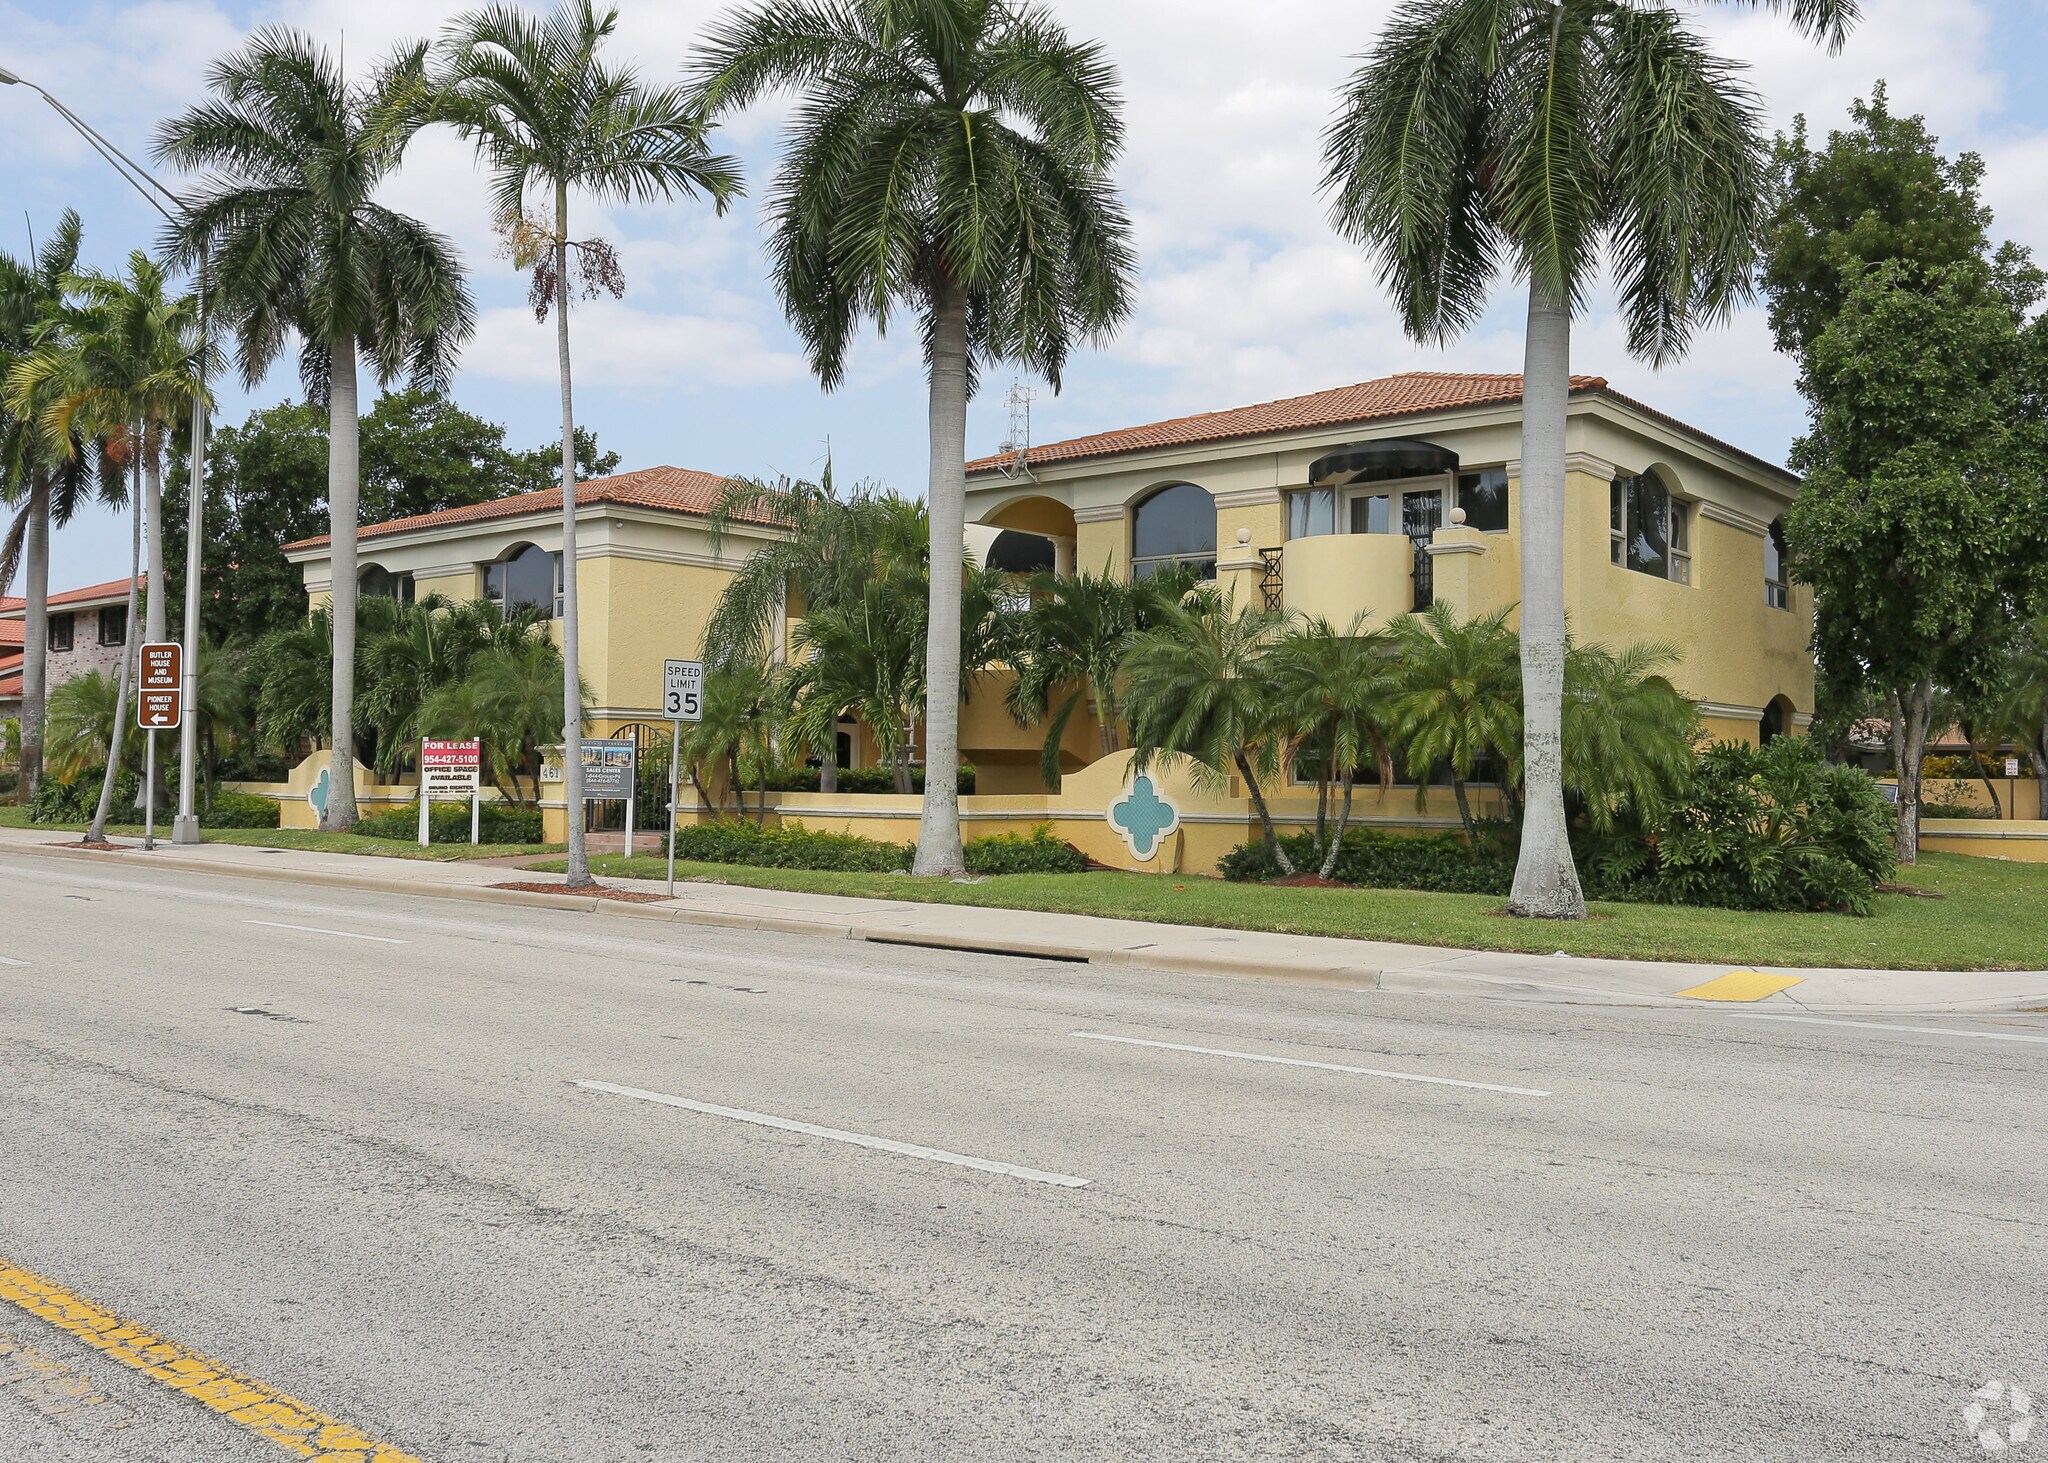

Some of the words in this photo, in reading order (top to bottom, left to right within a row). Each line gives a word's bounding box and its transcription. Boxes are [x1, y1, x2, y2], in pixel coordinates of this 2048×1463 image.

[667, 666, 701, 678] SPEED
[670, 679, 697, 689] LIMIT
[667, 692, 698, 715] 35
[424, 742, 444, 750] FOR
[446, 742, 478, 750] LEASE
[424, 755, 478, 764] 954-427-5100
[543, 767, 559, 779] 461
